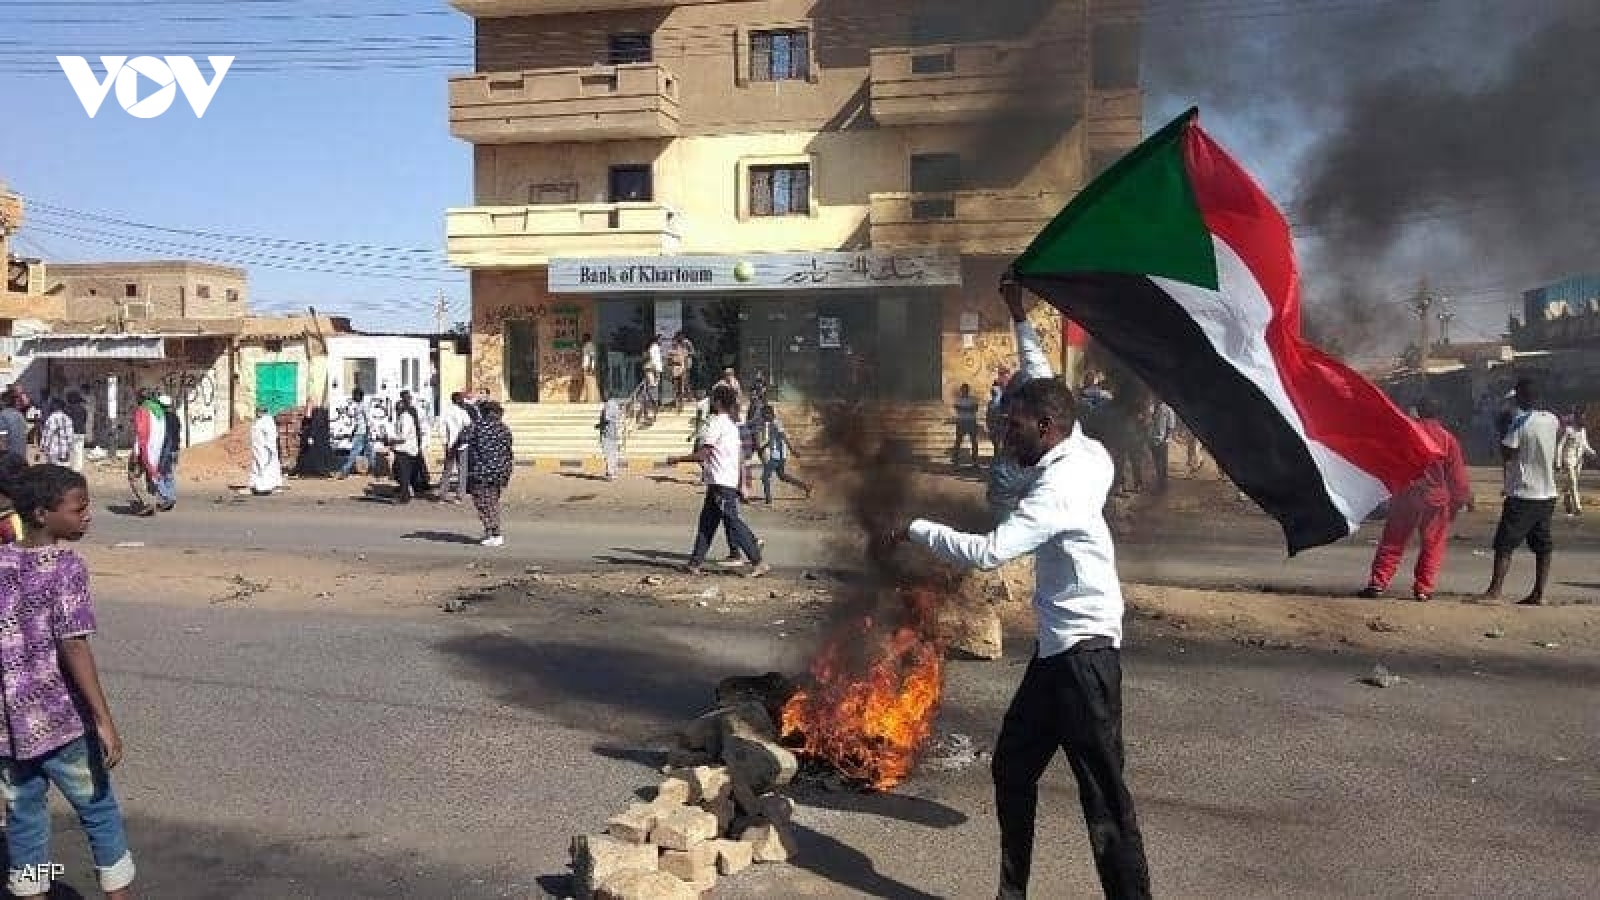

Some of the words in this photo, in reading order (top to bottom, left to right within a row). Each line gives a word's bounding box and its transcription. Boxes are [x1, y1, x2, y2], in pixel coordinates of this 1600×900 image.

[580, 265, 617, 283] Bank
[620, 265, 637, 283] of
[639, 265, 713, 283] Khartoum
